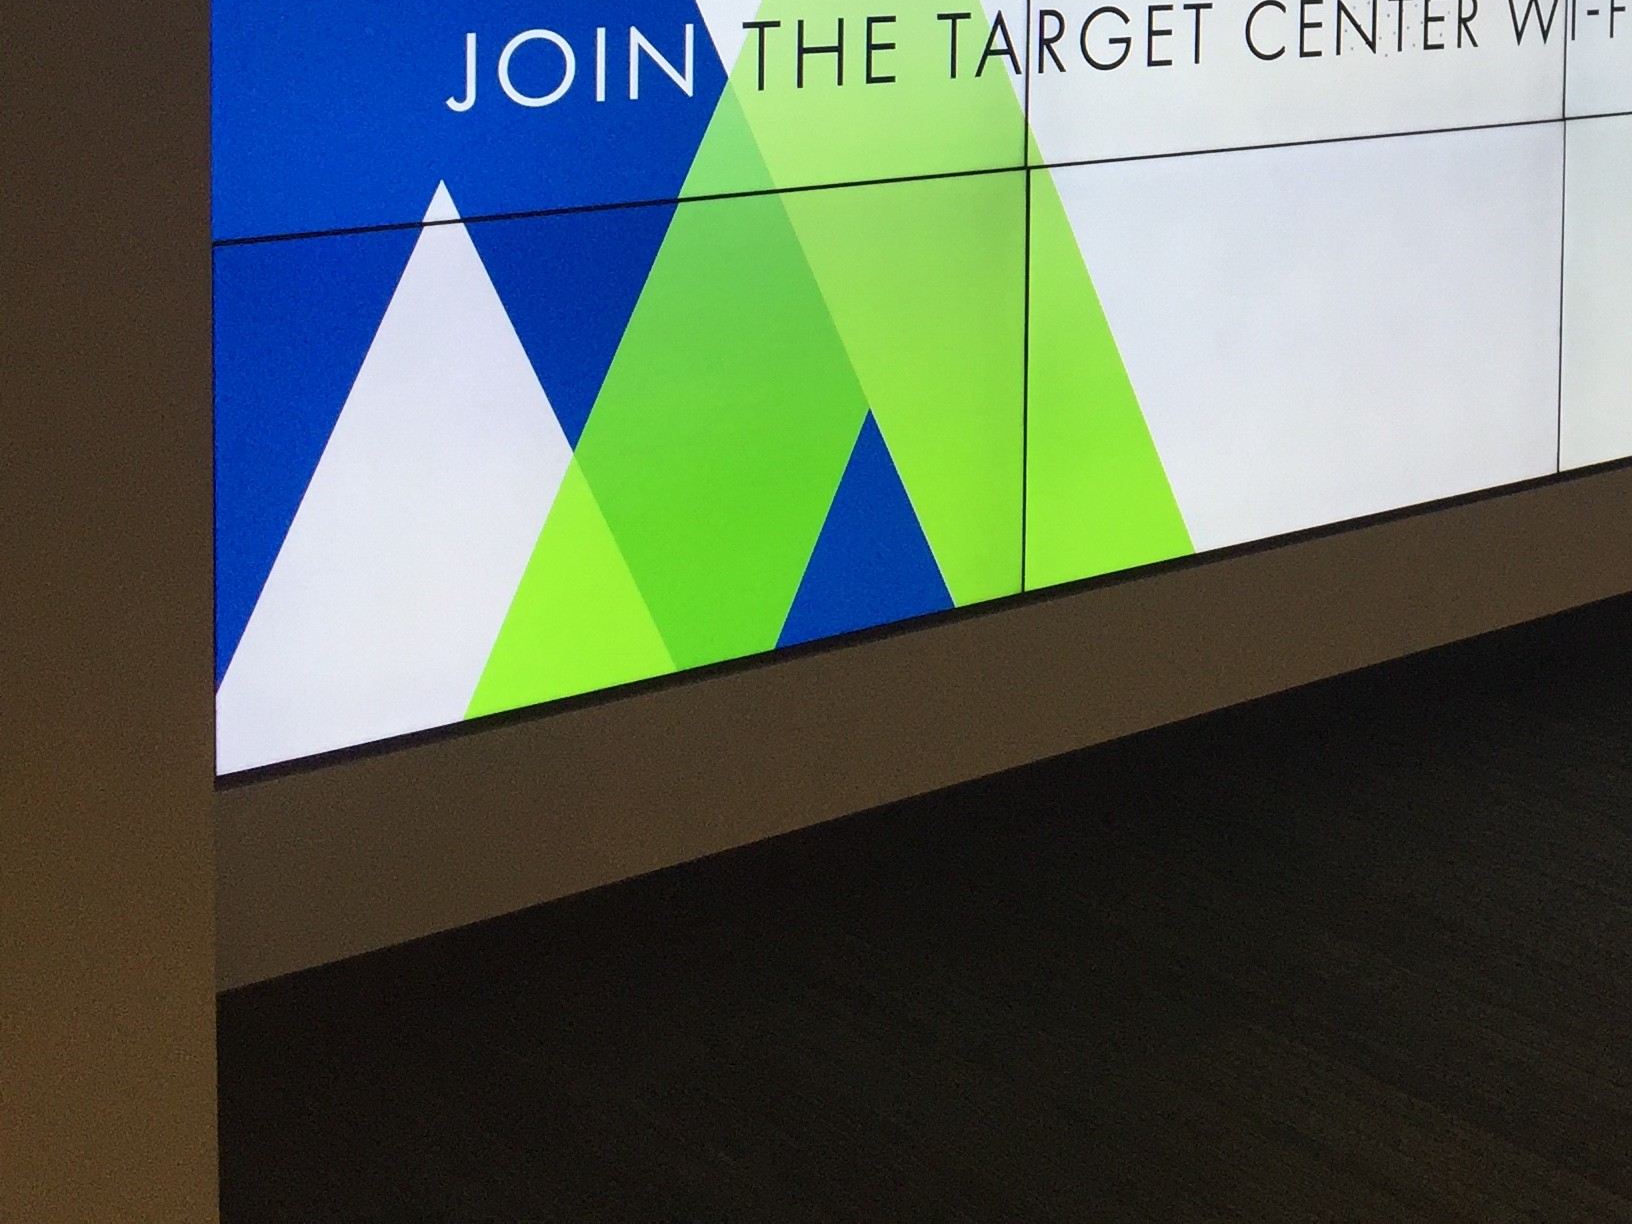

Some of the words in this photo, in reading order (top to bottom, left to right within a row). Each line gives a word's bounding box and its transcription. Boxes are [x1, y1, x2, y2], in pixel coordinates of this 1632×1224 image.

[446, 23, 694, 112] JOIN
[742, 15, 896, 91] THE
[937, 2, 1213, 79] TARGET
